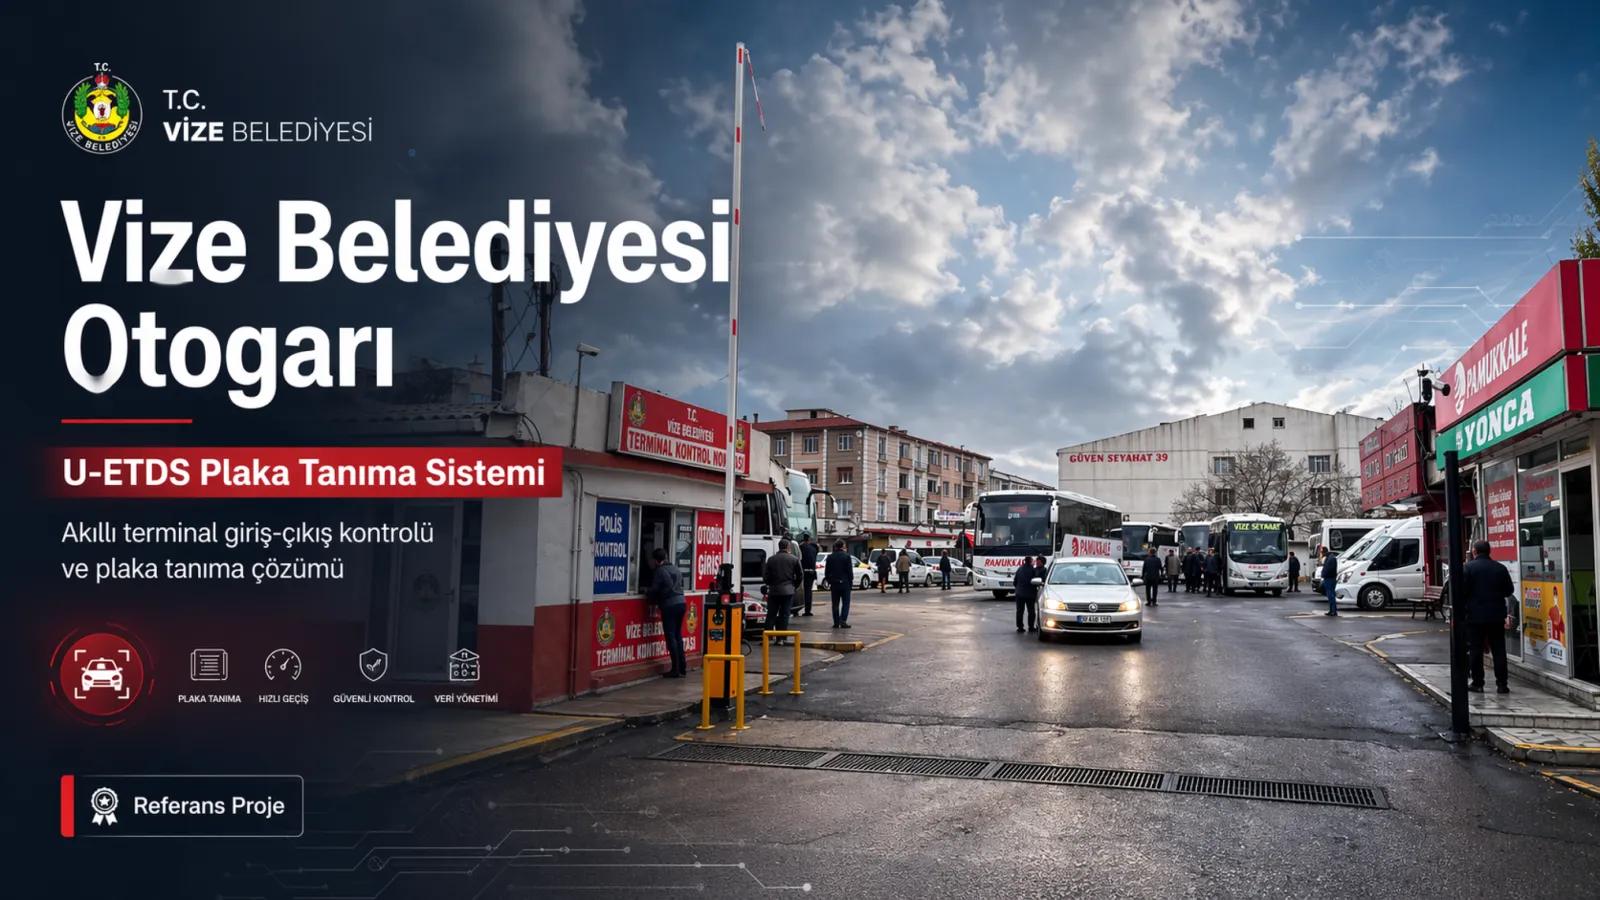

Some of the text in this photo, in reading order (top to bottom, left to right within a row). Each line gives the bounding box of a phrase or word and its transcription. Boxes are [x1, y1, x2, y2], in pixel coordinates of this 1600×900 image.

[1466, 319, 1529, 399] PAMUKKALE
[687, 407, 698, 423] T.C.
[1464, 387, 1535, 452] YONCA
[667, 417, 681, 436] VİZE
[628, 429, 673, 457] TERMİNAL
[674, 441, 712, 466] KONTROL
[1069, 452, 1169, 463] GÜVEN SEYAHAT 39
[599, 513, 623, 534] POLİS
[697, 524, 723, 546] OTOBÜS
[594, 541, 627, 558] KONTROL
[594, 565, 625, 582] NOKTASI
[625, 621, 641, 640] VİZE
[597, 642, 635, 666] TERMİNAL
